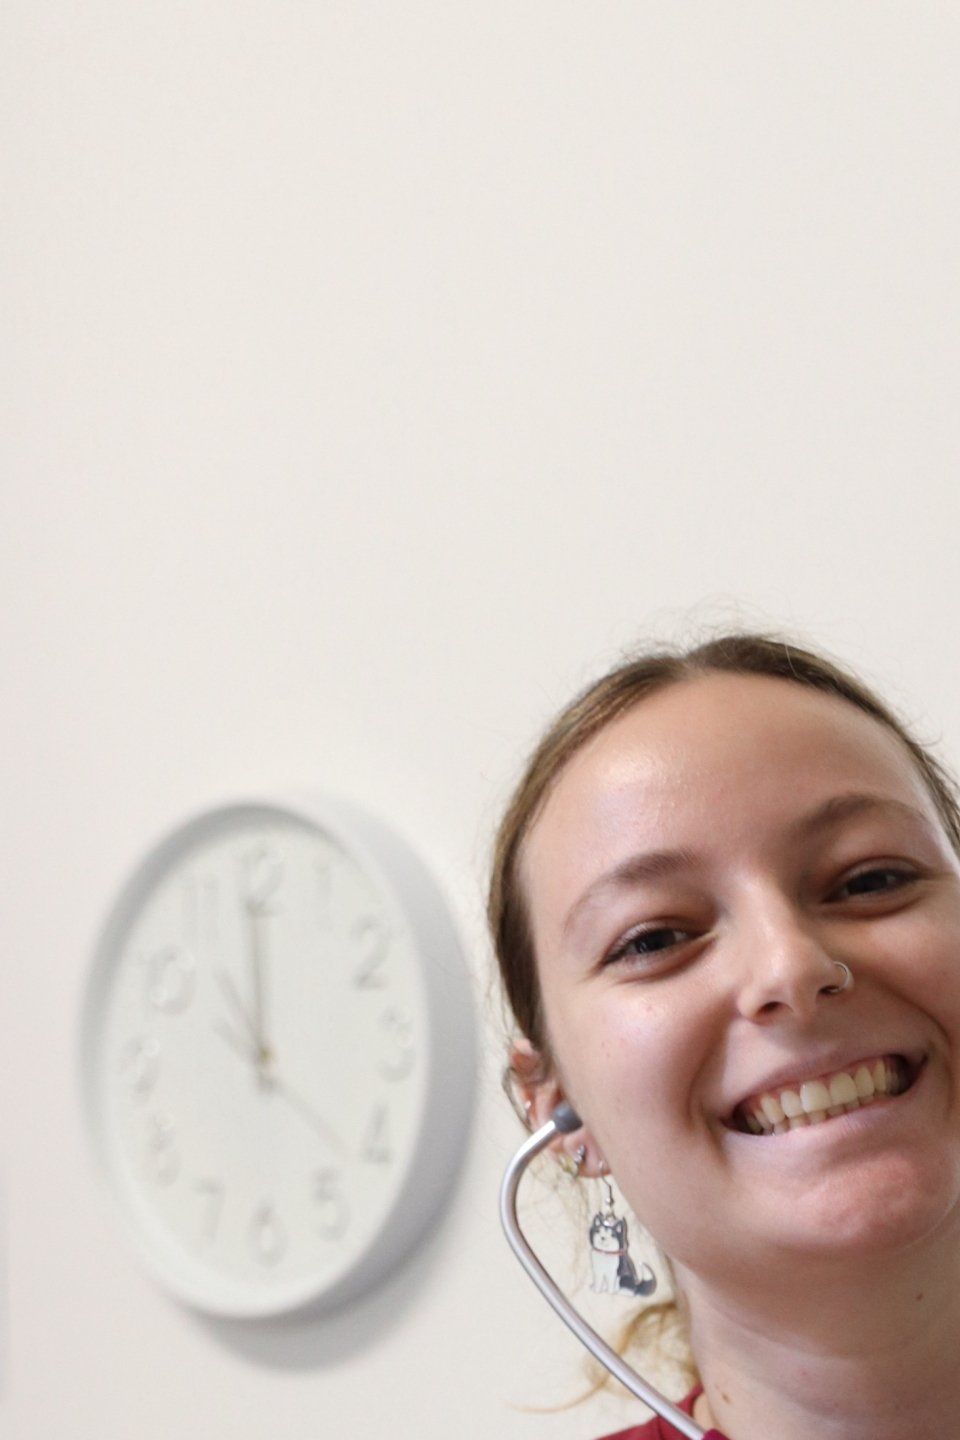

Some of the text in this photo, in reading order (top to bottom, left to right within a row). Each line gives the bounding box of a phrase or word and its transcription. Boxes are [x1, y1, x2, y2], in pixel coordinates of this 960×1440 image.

[349, 912, 391, 991] 2
[118, 1034, 162, 1106] 9
[375, 1005, 417, 1083] 3
[146, 1110, 183, 1188] 8
[359, 1100, 396, 1166] 4
[191, 1175, 226, 1244] 7
[246, 1192, 289, 1267] 6
[310, 1164, 351, 1242] 5
